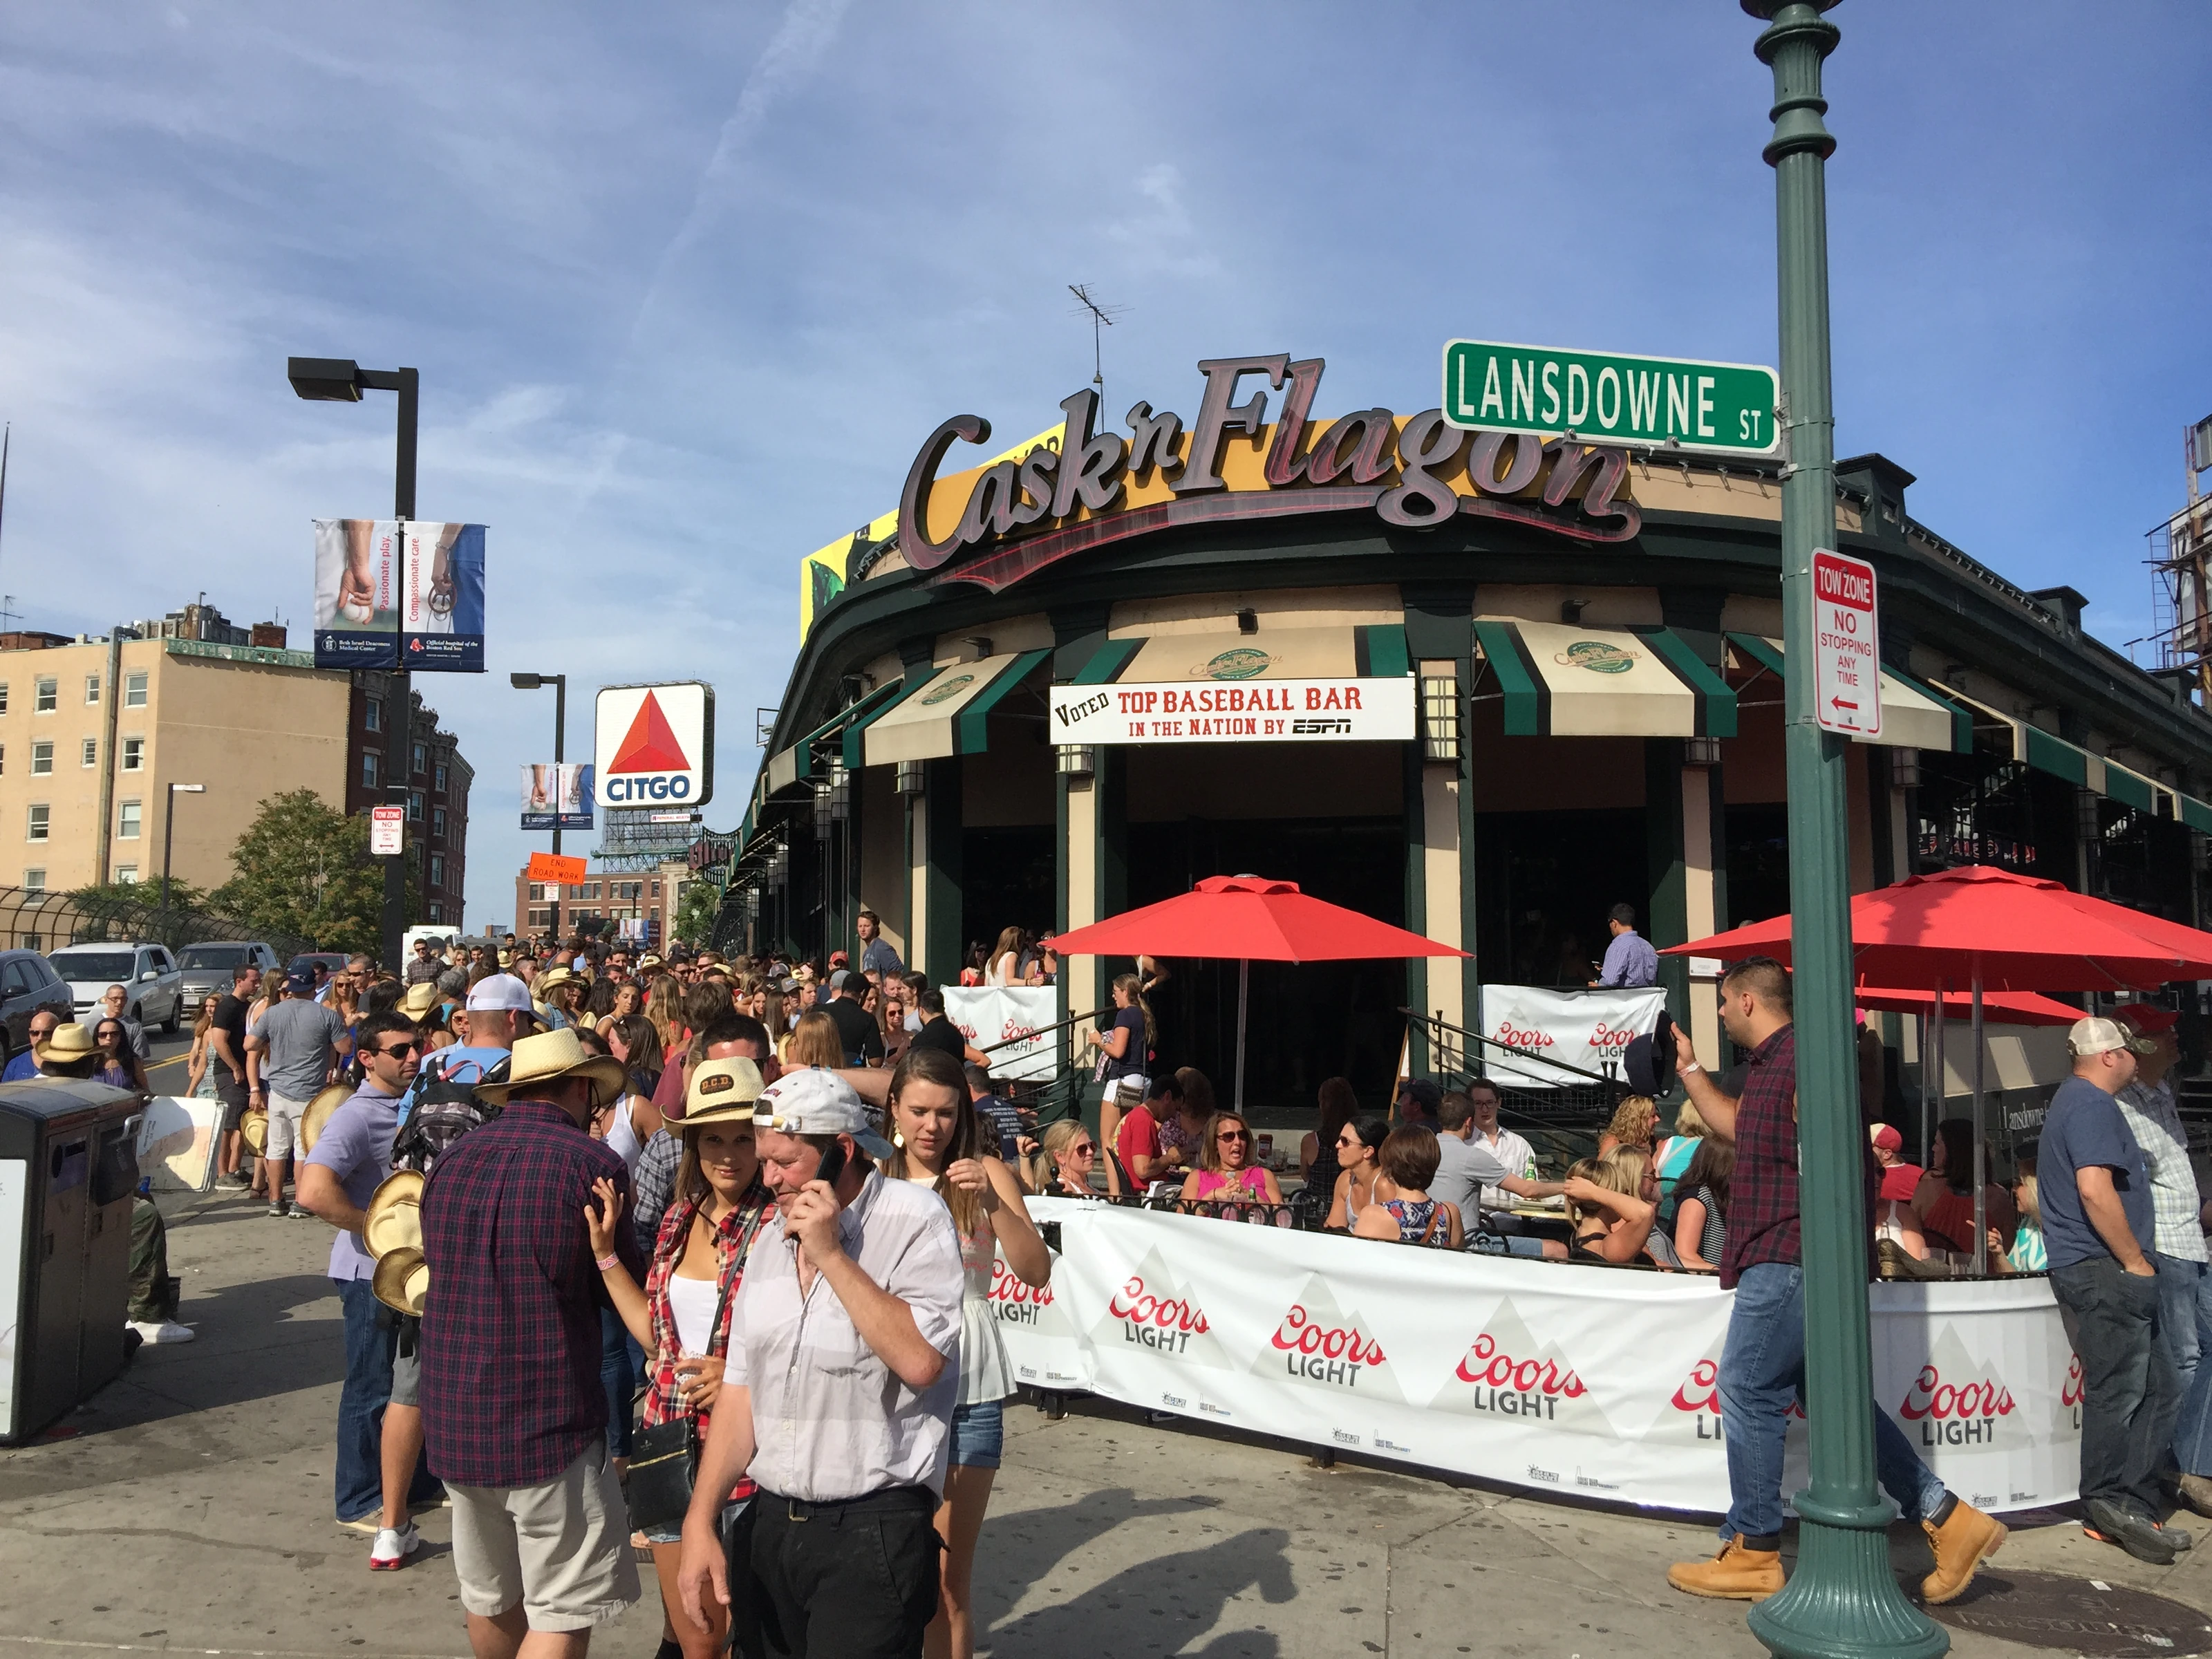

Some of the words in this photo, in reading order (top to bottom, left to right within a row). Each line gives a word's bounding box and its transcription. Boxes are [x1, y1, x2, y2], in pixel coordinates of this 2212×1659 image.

[1456, 353, 1716, 438] LANSDOWNE
[1739, 409, 1761, 441] ST
[899, 388, 1125, 570] Cask
[1168, 353, 1641, 543] Flagon
[382, 535, 393, 558] play.
[379, 559, 390, 611] Passionate
[409, 559, 421, 622] Compassionate
[1818, 566, 1841, 596] TOW
[1843, 573, 1871, 604] ZONE
[1834, 609, 1857, 634] NO
[1820, 632, 1871, 657] STOPPING
[1837, 655, 1856, 671] ANY
[1837, 671, 1858, 686] TIME
[1054, 692, 1109, 728] VOTED
[1118, 692, 1158, 714] TOP
[1163, 688, 1295, 713] BASEBALL
[1305, 686, 1363, 711] BAR
[1129, 722, 1145, 737] IN
[1152, 721, 1183, 737] THE
[1189, 718, 1257, 736] NATION
[1264, 720, 1285, 735] BY
[1292, 719, 1351, 734] ESPN
[606, 775, 690, 802] CITGO
[375, 811, 386, 819] TOW
[386, 810, 400, 818] ZONE
[534, 868, 554, 878] ROAD
[558, 870, 579, 881] WORK
[550, 859, 566, 868] END
[1492, 1022, 1555, 1047] Coors
[1588, 1022, 1641, 1046] Coor
[1598, 1046, 1626, 1058] LIGH
[1109, 1275, 1210, 1334] Coors
[1125, 1321, 1191, 1354] LIGHT
[1271, 1304, 1387, 1366] Coors
[1287, 1353, 1362, 1387] LIGHT
[1455, 1333, 1588, 1399] Coors
[1474, 1385, 1559, 1421] LIGHT
[1900, 1365, 2016, 1421] Coors
[1922, 1418, 1995, 1446] LIGHT
